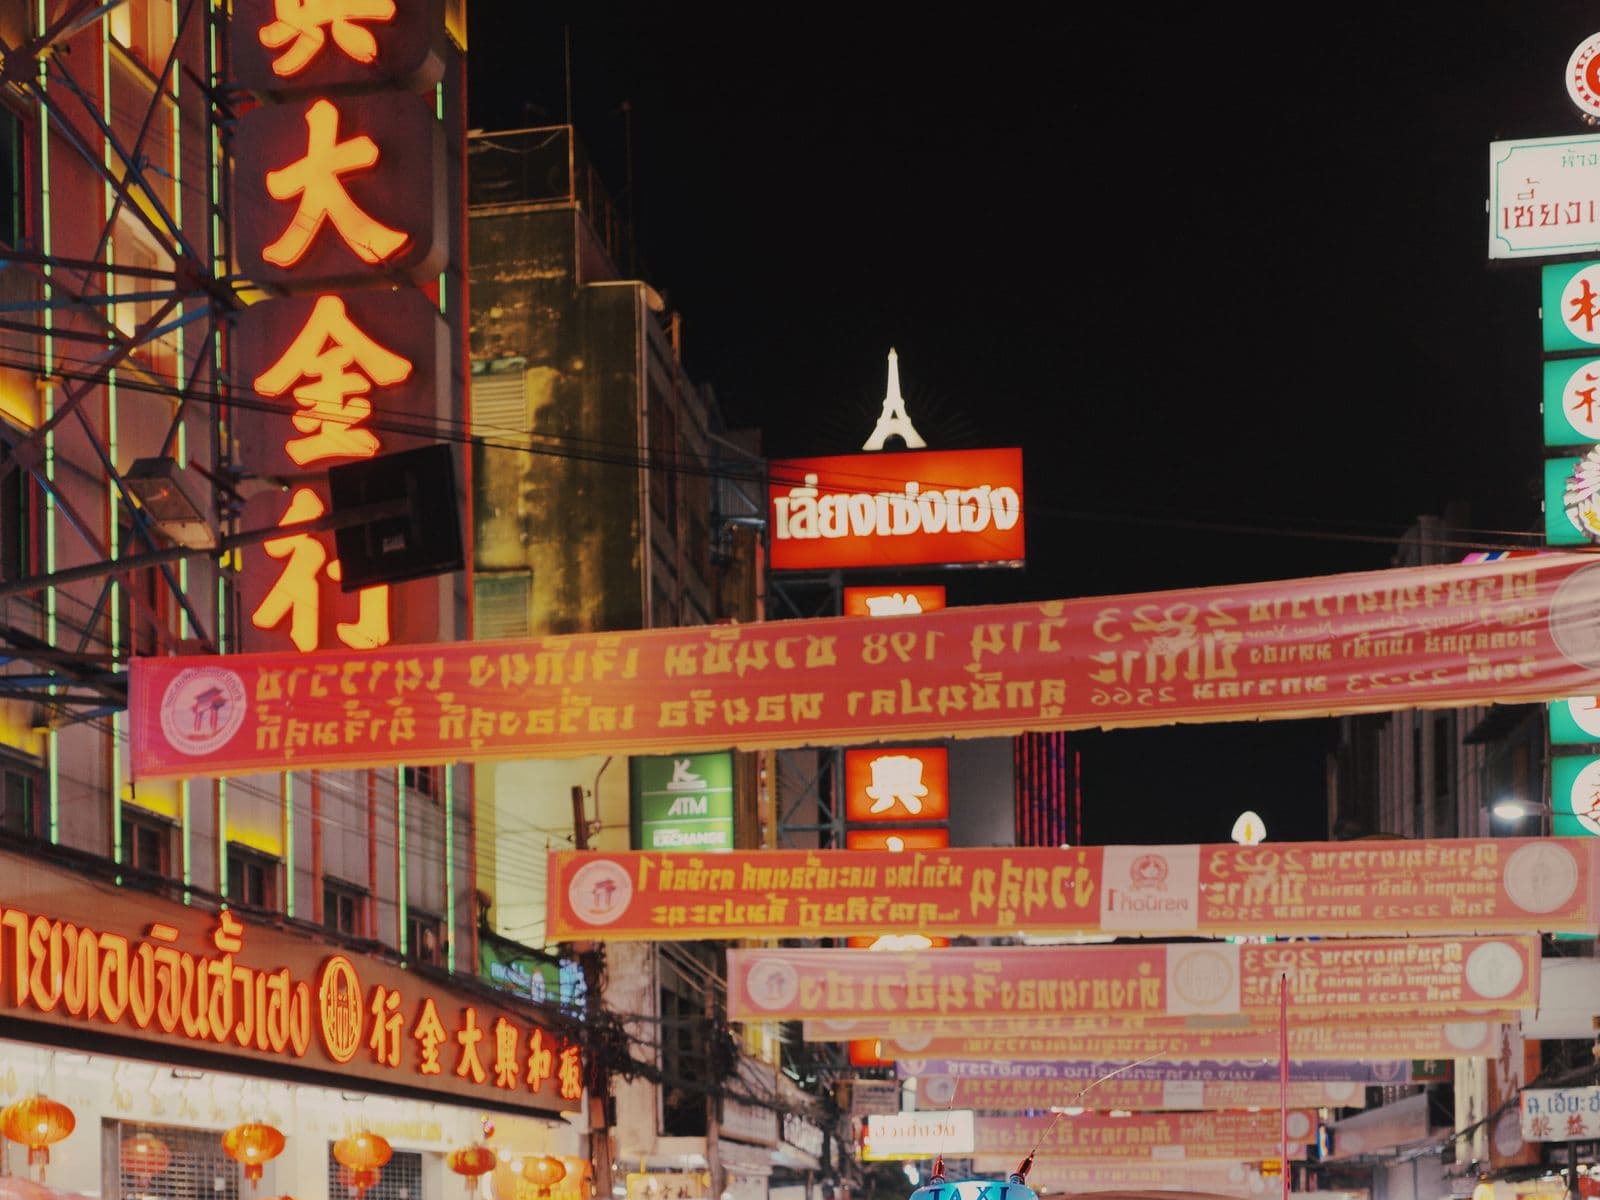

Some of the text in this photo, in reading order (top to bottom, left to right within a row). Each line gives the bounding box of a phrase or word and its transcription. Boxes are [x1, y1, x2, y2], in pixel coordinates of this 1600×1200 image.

[774, 473, 1020, 540] เลี่ยงเซ่งเฮง
[667, 796, 707, 816] ATM
[653, 830, 727, 848] EXCHANGE
[0, 909, 312, 1059] ายทองจินฮั้วเฮง
